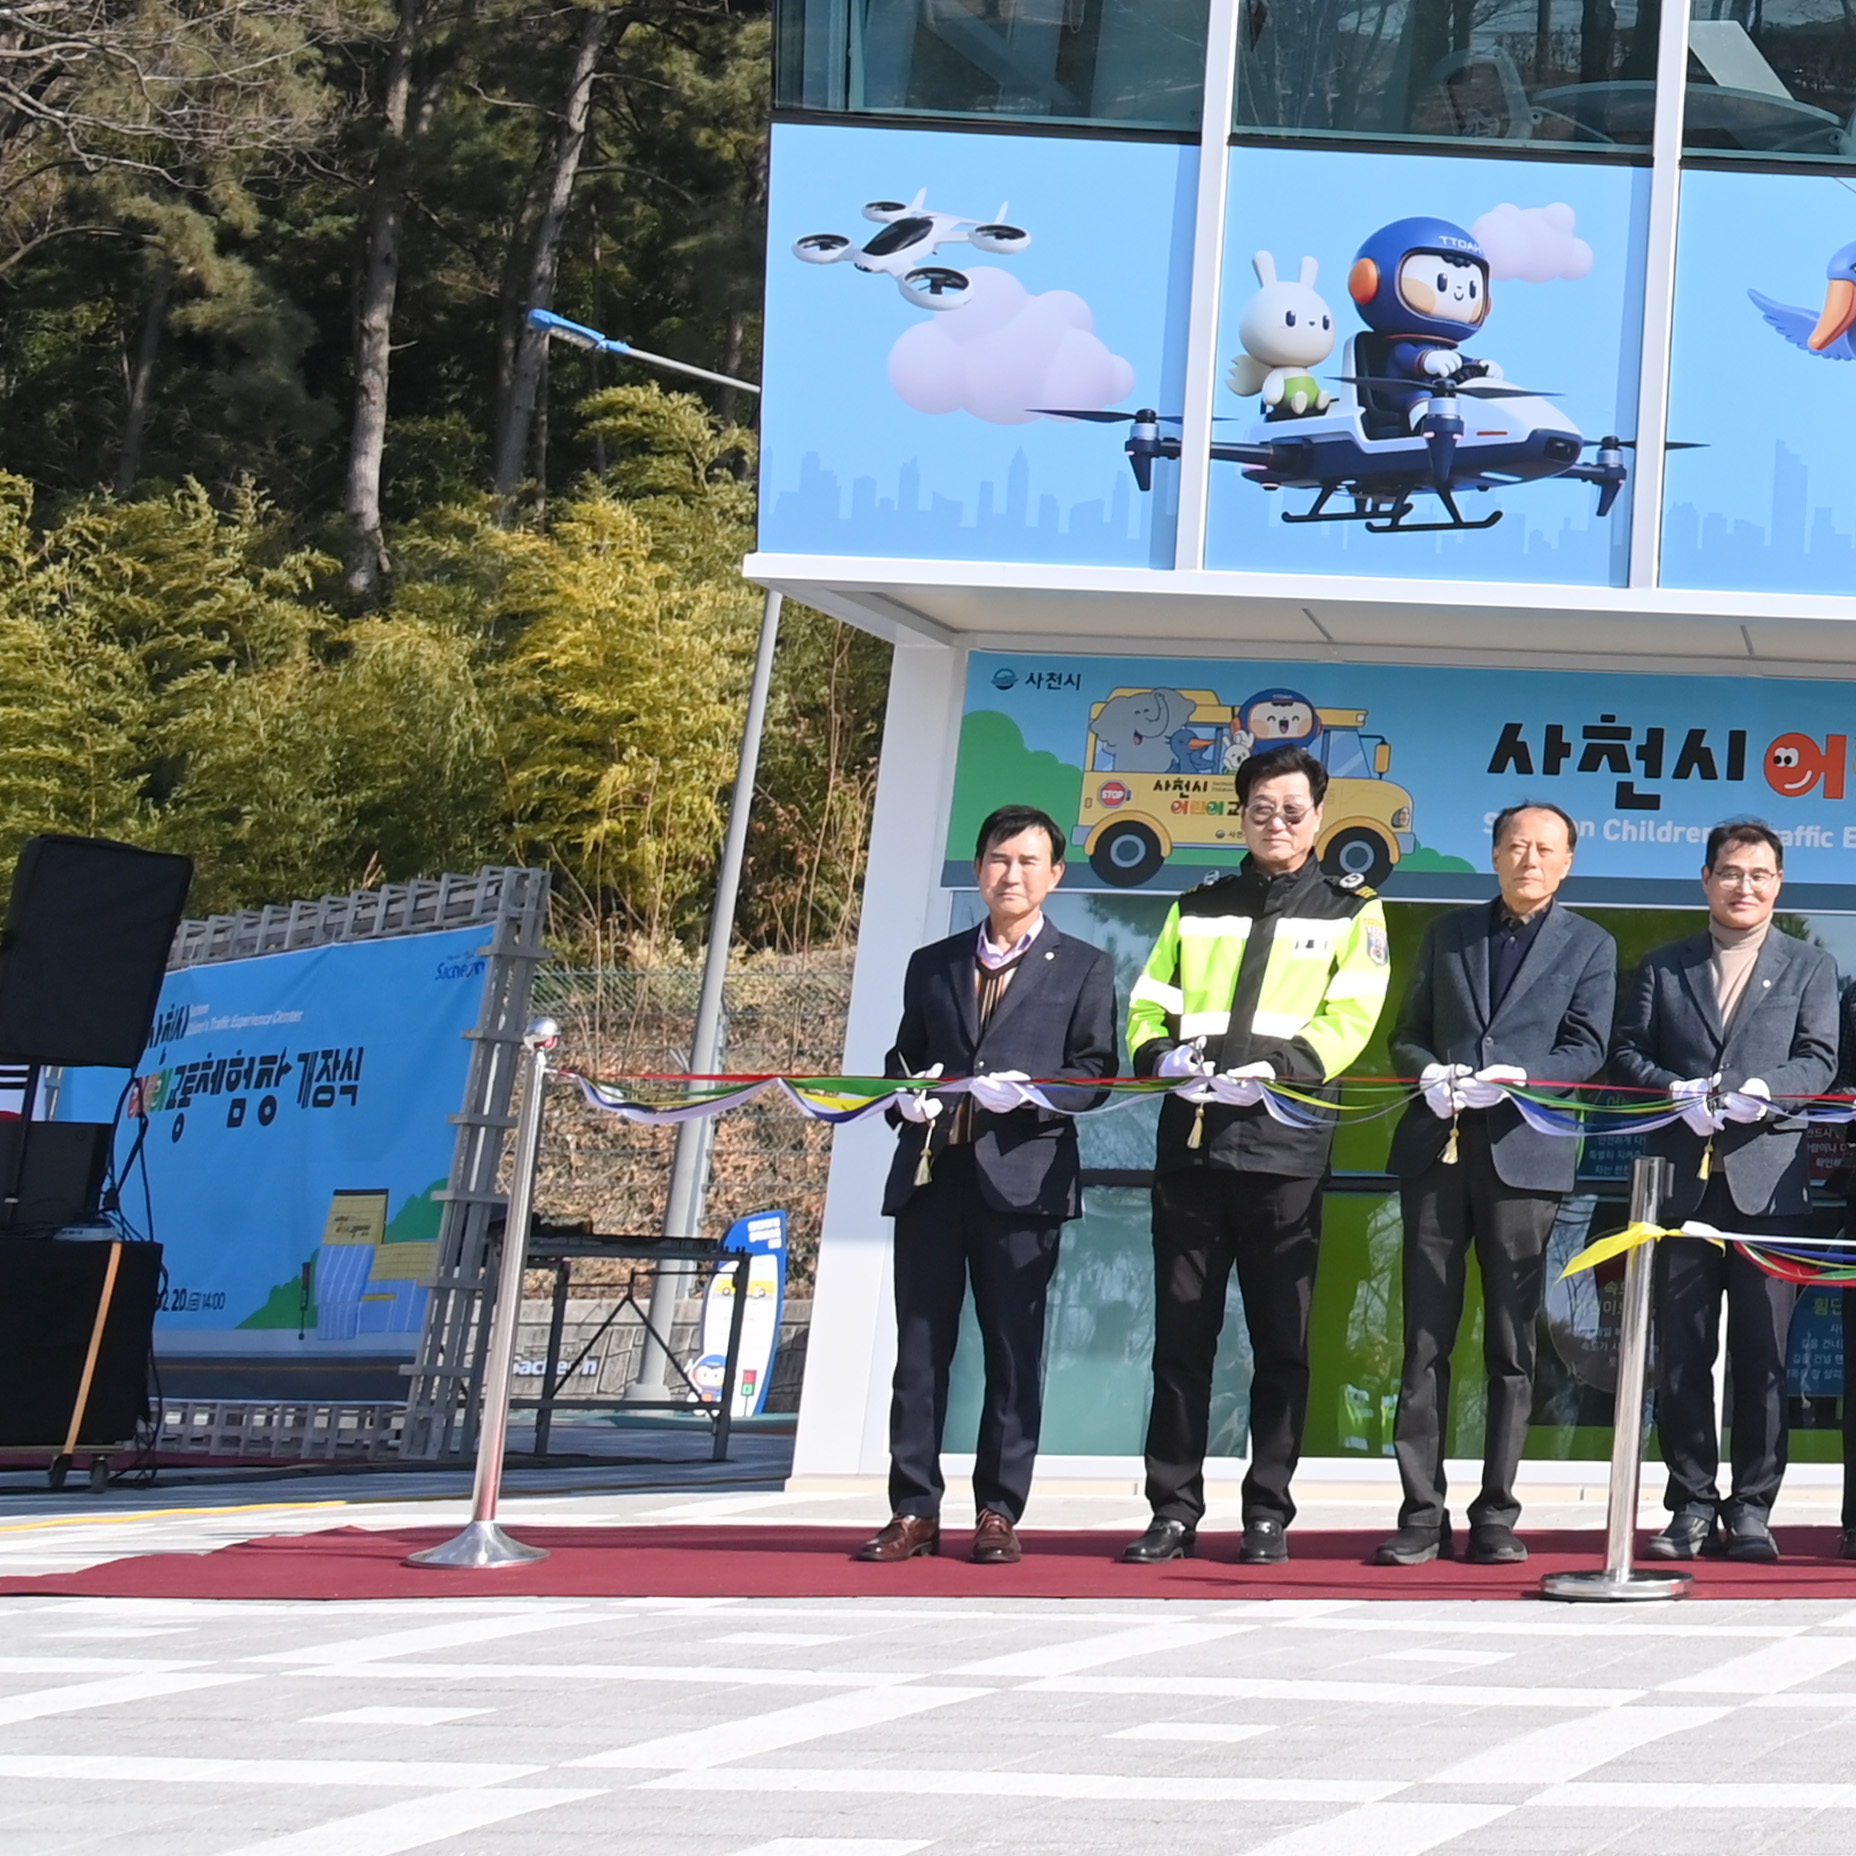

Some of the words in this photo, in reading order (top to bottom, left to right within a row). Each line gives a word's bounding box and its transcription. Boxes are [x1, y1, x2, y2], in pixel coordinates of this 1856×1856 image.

[1024, 671, 1082, 691] 사천시
[1487, 714, 1747, 811] 사천시
[1101, 789, 1125, 800] STOP
[1153, 777, 1209, 799] 사천시
[297, 1046, 365, 1109] 개장식
